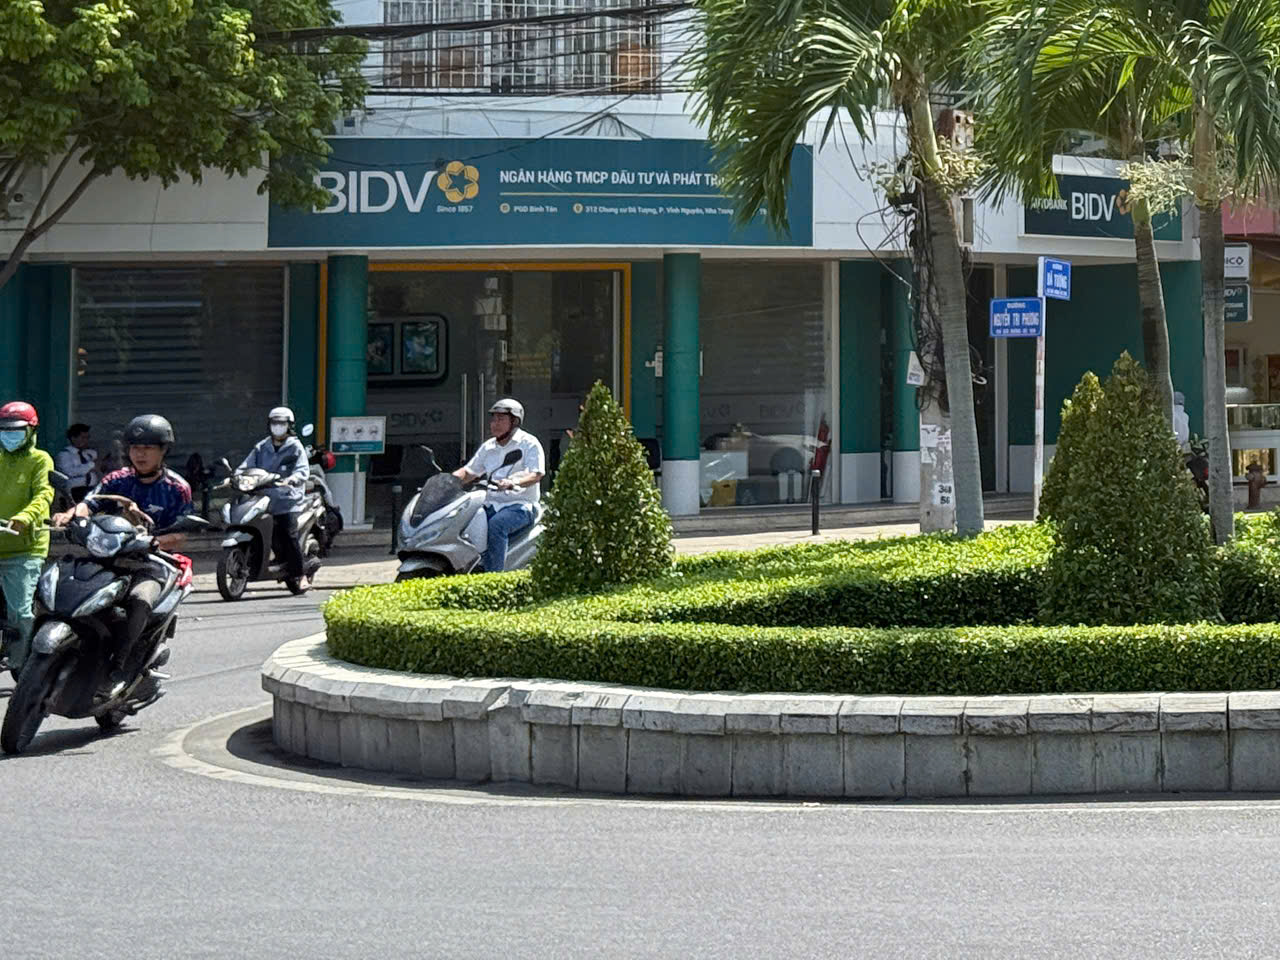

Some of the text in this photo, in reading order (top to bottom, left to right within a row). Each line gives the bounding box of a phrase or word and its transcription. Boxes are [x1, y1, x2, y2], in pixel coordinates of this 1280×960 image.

[312, 171, 438, 213] BIDV
[500, 168, 535, 183] NGÂN
[538, 168, 572, 183] HÀNG
[575, 171, 608, 184] TMCP
[638, 171, 655, 185] TƯ
[656, 171, 671, 185] VÀ
[673, 171, 702, 186] PHÁT
[1071, 191, 1116, 221] BIDV
